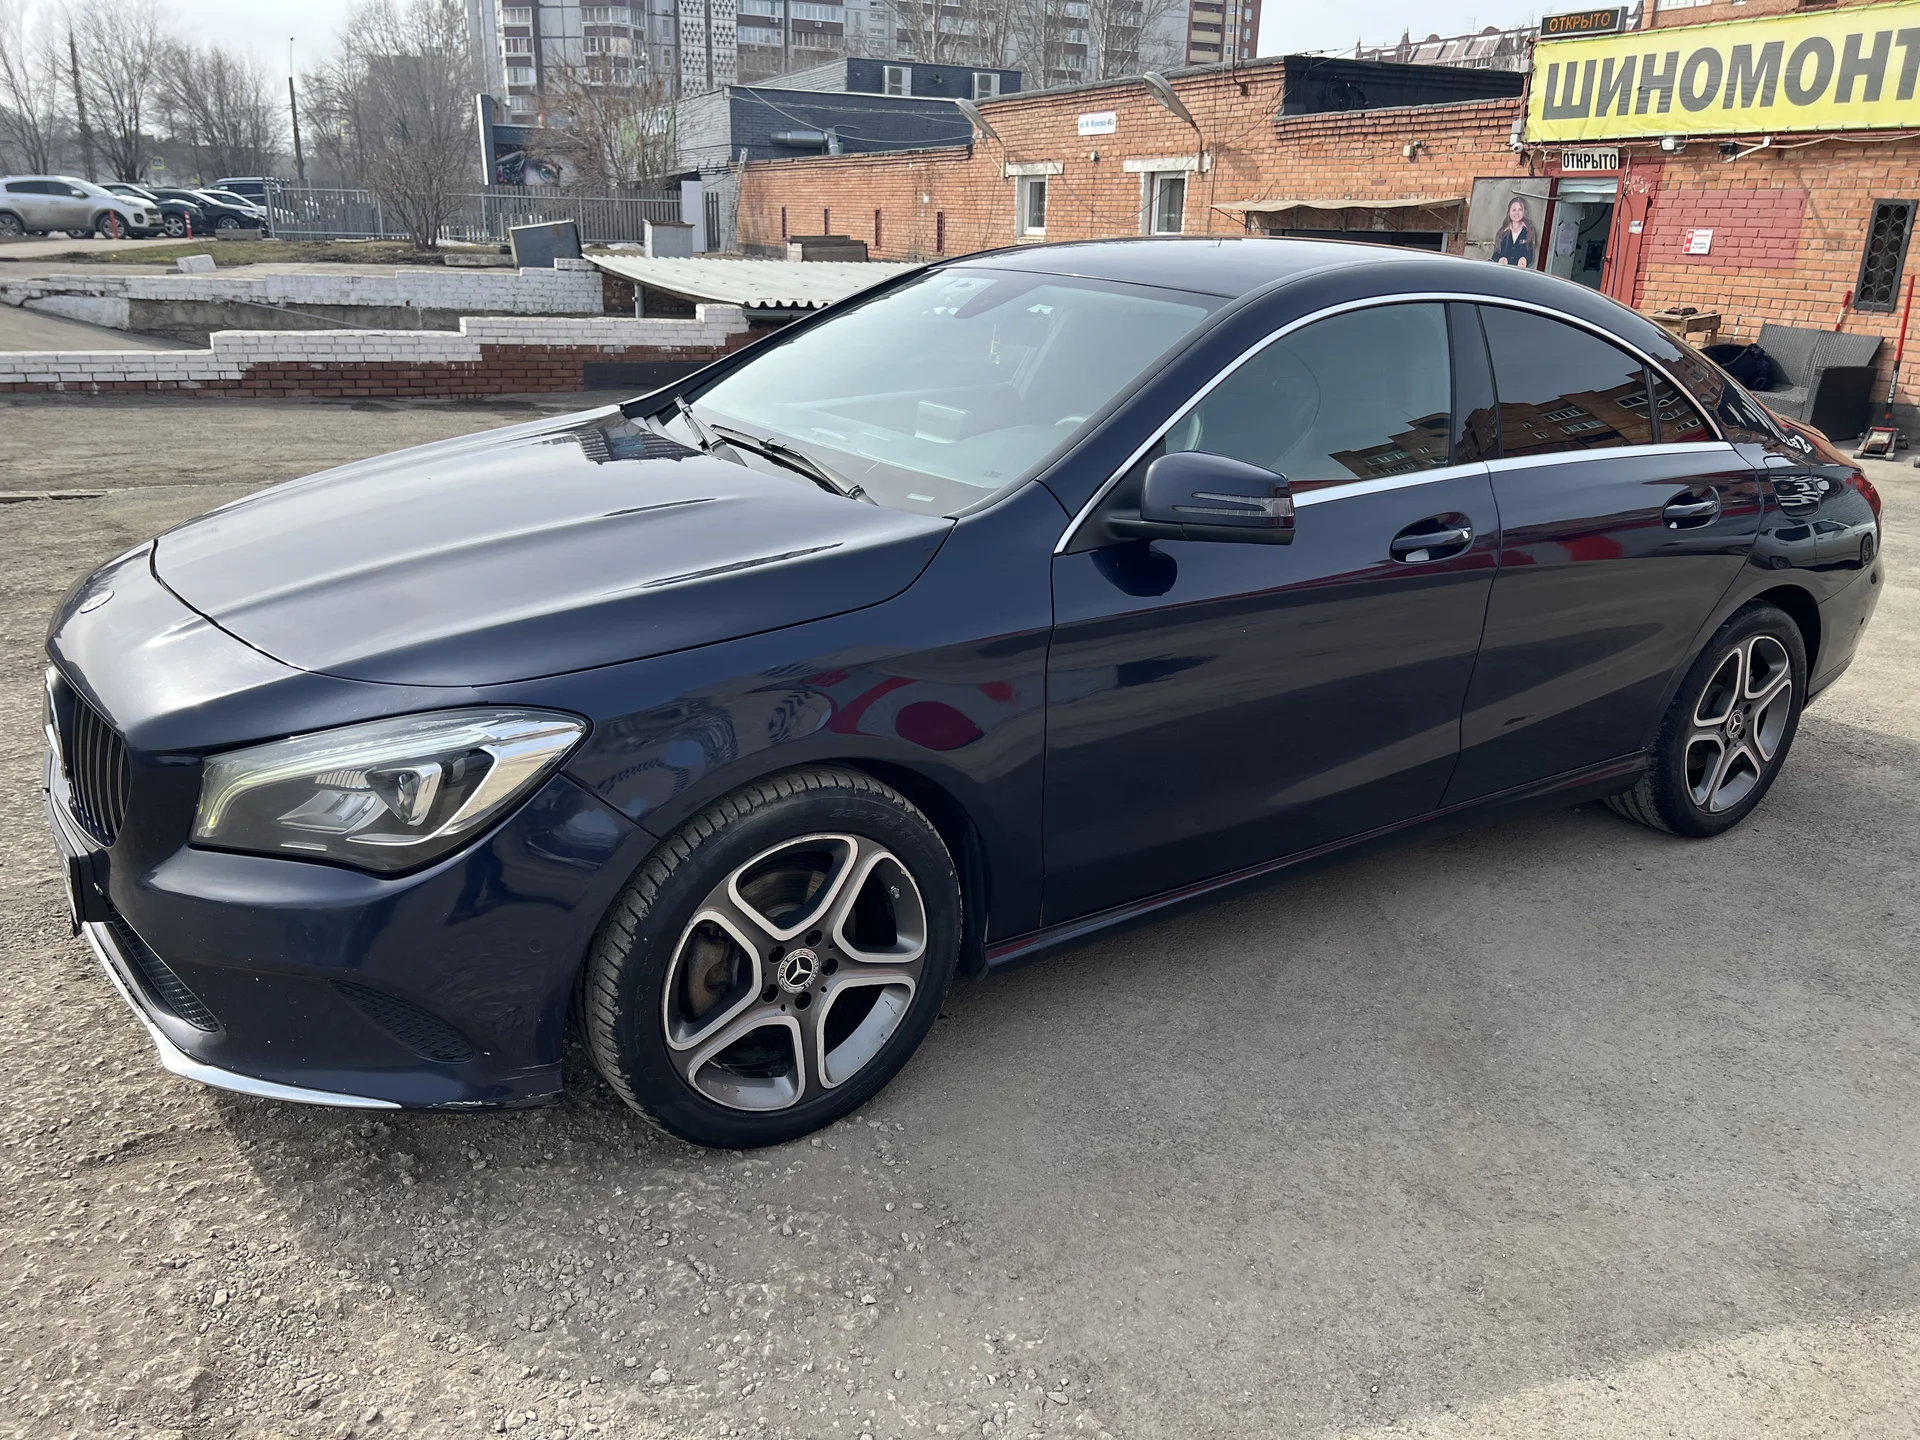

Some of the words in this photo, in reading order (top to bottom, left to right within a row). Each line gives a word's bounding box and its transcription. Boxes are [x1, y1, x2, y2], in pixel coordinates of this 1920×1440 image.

[1549, 12, 1611, 32] ОТКРЫТО
[1542, 27, 1920, 120] ШИНОМОНТ
[1563, 153, 1617, 169] ОТКРЫТО
